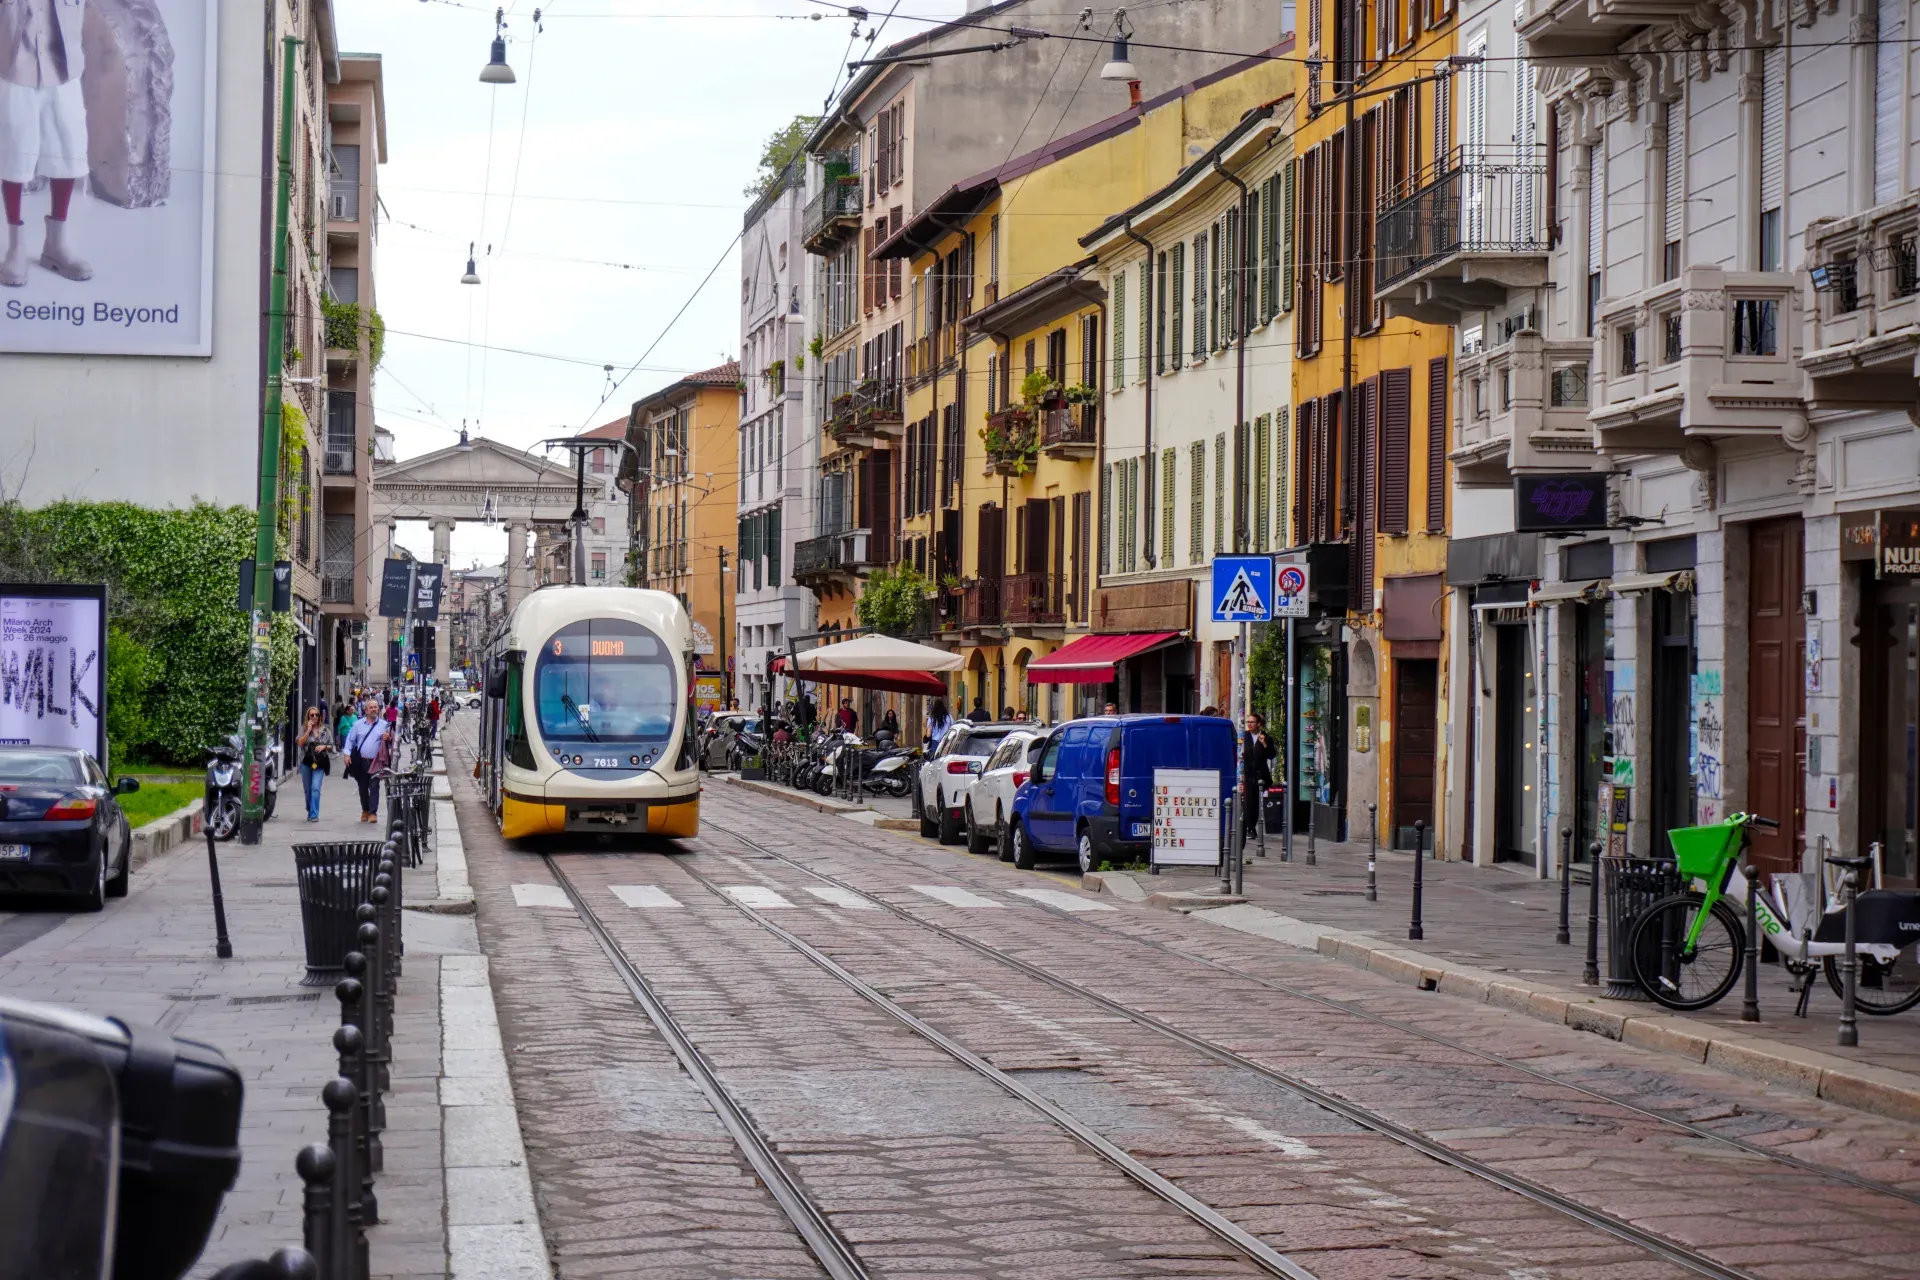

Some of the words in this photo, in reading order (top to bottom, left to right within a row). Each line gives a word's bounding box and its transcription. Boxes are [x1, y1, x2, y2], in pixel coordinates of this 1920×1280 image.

[5, 299, 85, 327] Seeing
[93, 302, 179, 328] Beyond
[390, 492, 436, 503] DEDIC
[1884, 564, 1920, 574] PROJE
[3, 618, 31, 626] Milano
[32, 618, 53, 626] Arch
[2, 626, 28, 634] Week
[29, 626, 52, 634] 2024
[2, 634, 14, 642] 20
[23, 634, 35, 642] 26
[36, 635, 68, 644] maggio
[553, 640, 563, 656] 3
[592, 640, 624, 656] DUOMO
[0, 647, 99, 729] WALK
[594, 758, 618, 767] 7613
[1155, 786, 1168, 795] LO
[1157, 797, 1217, 807] SPECCHIO
[1155, 818, 1171, 827] WE
[1155, 828, 1176, 837] ARE
[1155, 838, 1185, 848] OPEN
[0, 845, 22, 857] 5PJ
[1746, 900, 1780, 935] ime
